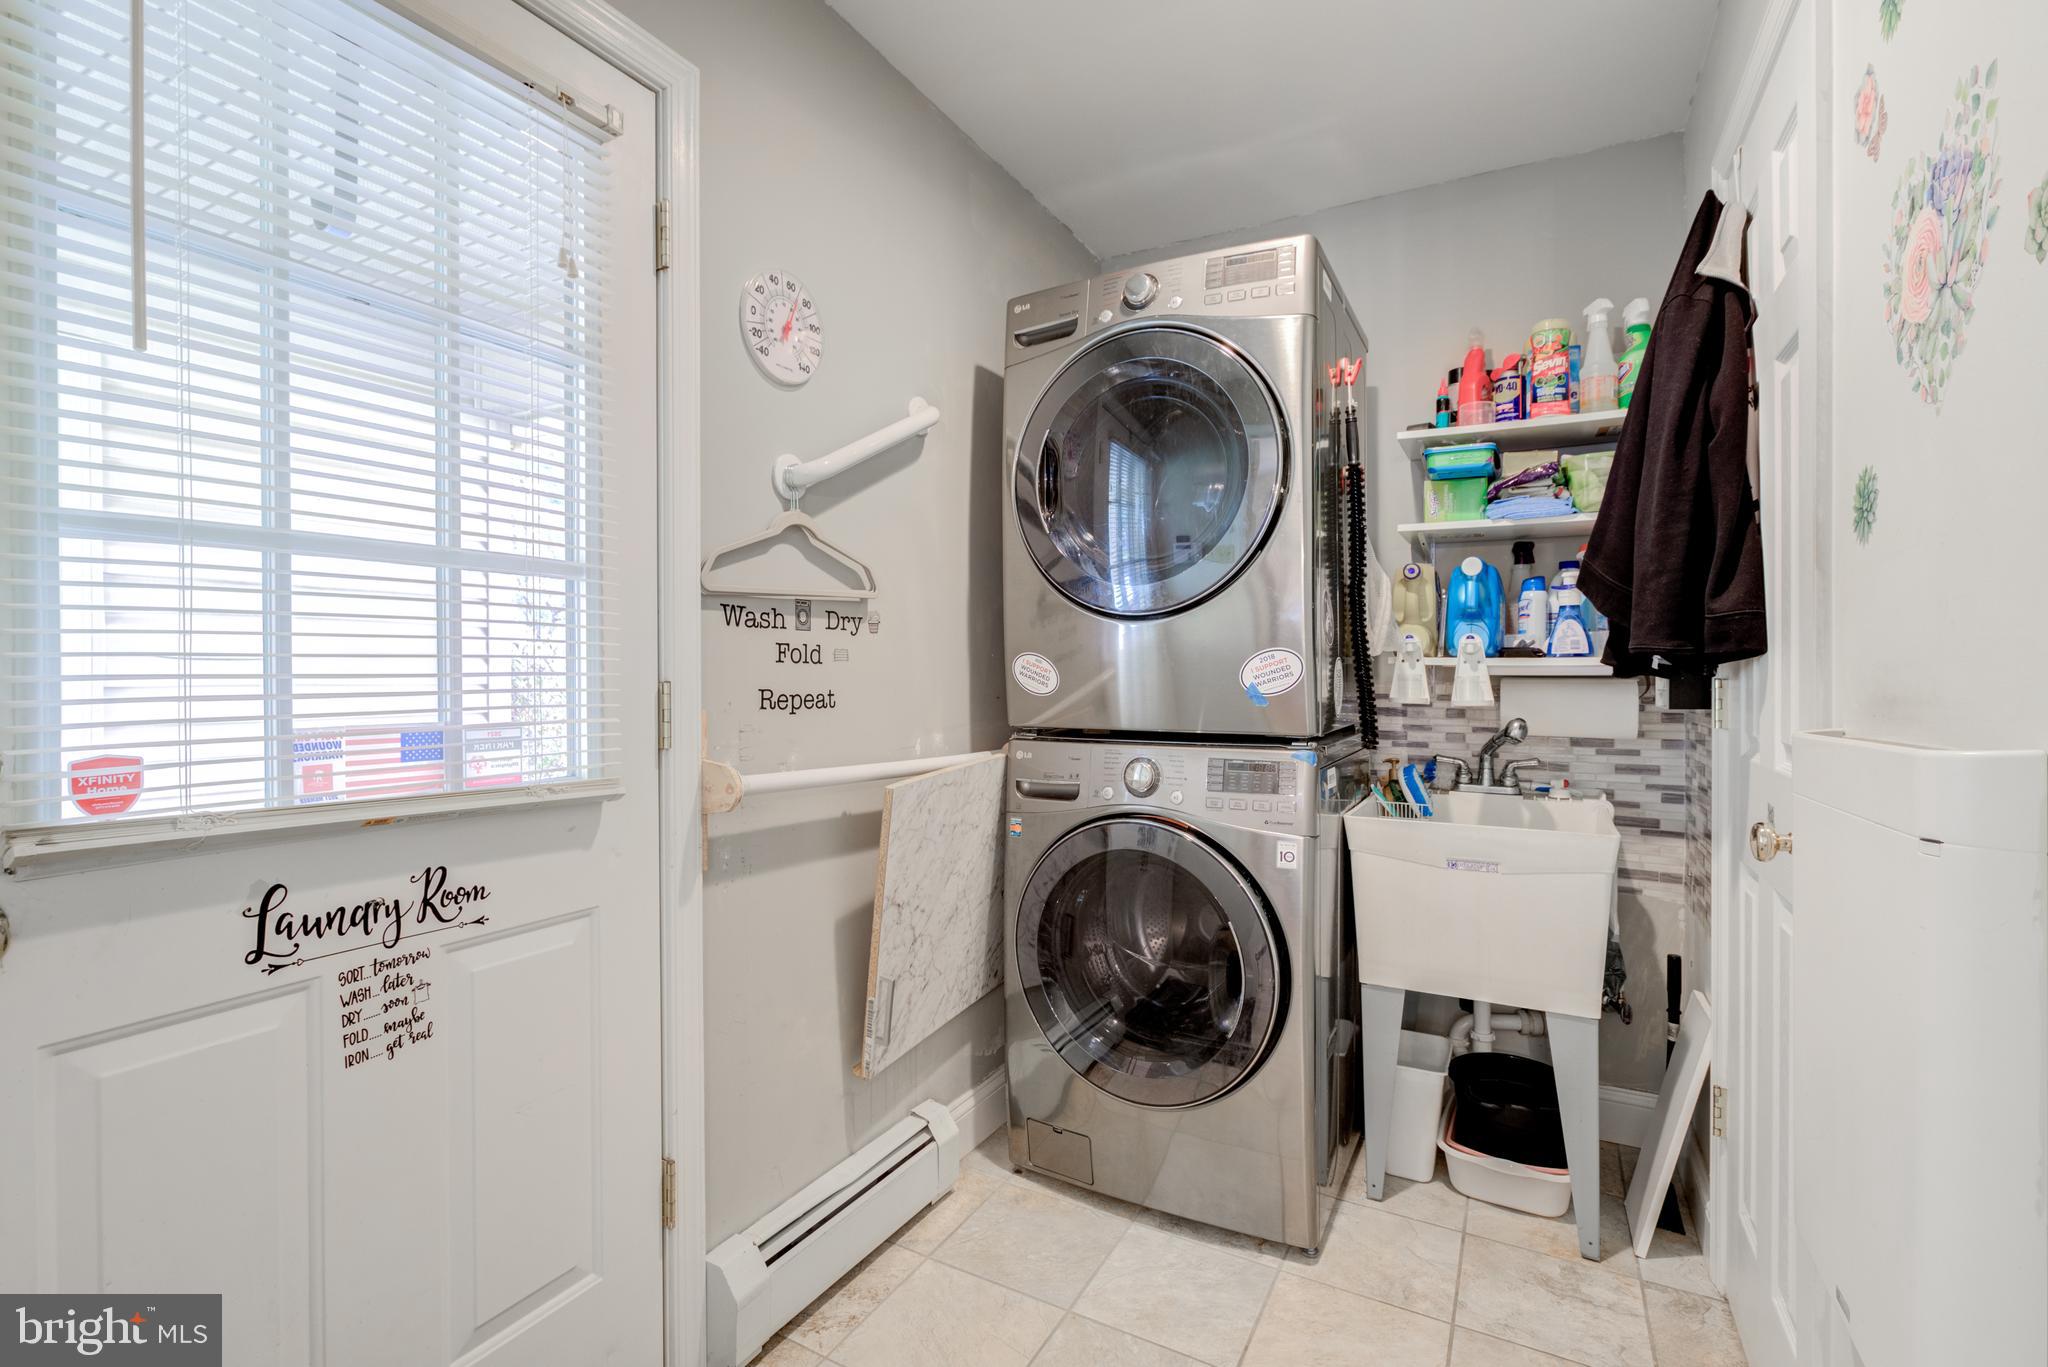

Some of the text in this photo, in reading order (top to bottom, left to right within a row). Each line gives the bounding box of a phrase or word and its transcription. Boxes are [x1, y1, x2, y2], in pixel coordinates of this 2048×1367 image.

[769, 274, 779, 286] 40
[786, 280, 796, 292] 60
[755, 285, 765, 295] 20
[750, 305, 757, 315] 0
[802, 298, 811, 310] 80
[748, 327, 763, 338] -20
[809, 323, 821, 335] 100
[755, 345, 770, 357] -40
[809, 346, 820, 357] 120
[1533, 357, 1567, 376] Sevin
[1495, 380, 1518, 394] D-40
[720, 603, 864, 637] Wash Dry
[775, 642, 823, 664] Fold
[1019, 671, 1049, 688] WARRIORS
[1020, 664, 1051, 682] WOUNDED
[1252, 664, 1291, 680] WOUNDED
[1254, 671, 1295, 687] WARRIORS
[758, 688, 836, 715] Repeat
[78, 773, 136, 787] XFINITY
[242, 866, 491, 965] Laundry Room
[369, 947, 431, 977] tomorrow
[380, 972, 415, 993] later
[380, 996, 409, 1014] soon
[383, 1006, 425, 1034] maybe
[386, 1034, 406, 1061] get
[408, 1021, 434, 1045] real
